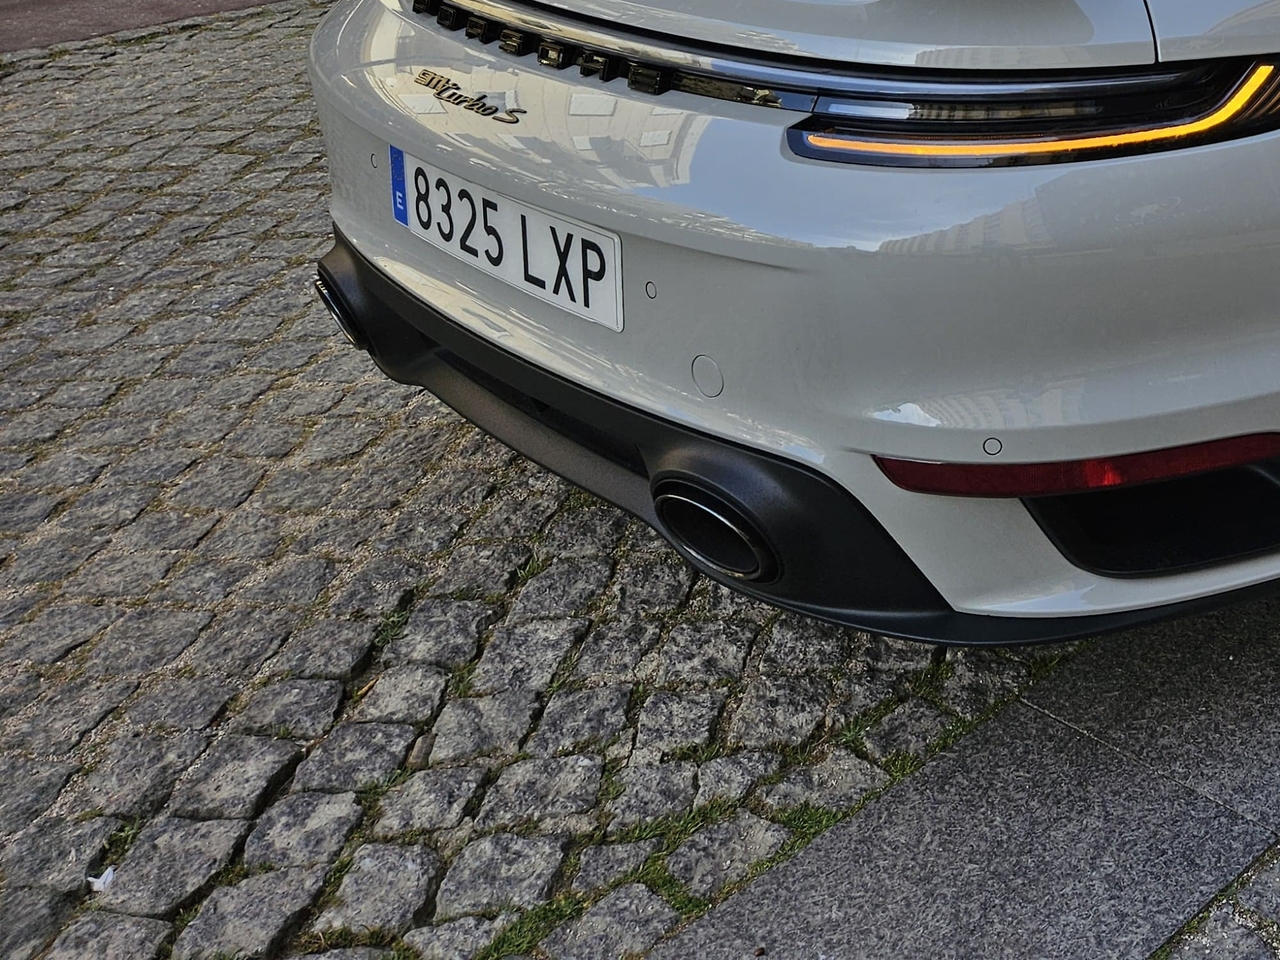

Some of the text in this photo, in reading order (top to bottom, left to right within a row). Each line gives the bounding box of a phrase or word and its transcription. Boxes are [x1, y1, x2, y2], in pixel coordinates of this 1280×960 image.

[492, 108, 528, 125] S
[396, 166, 606, 309] E 8325 LXP
